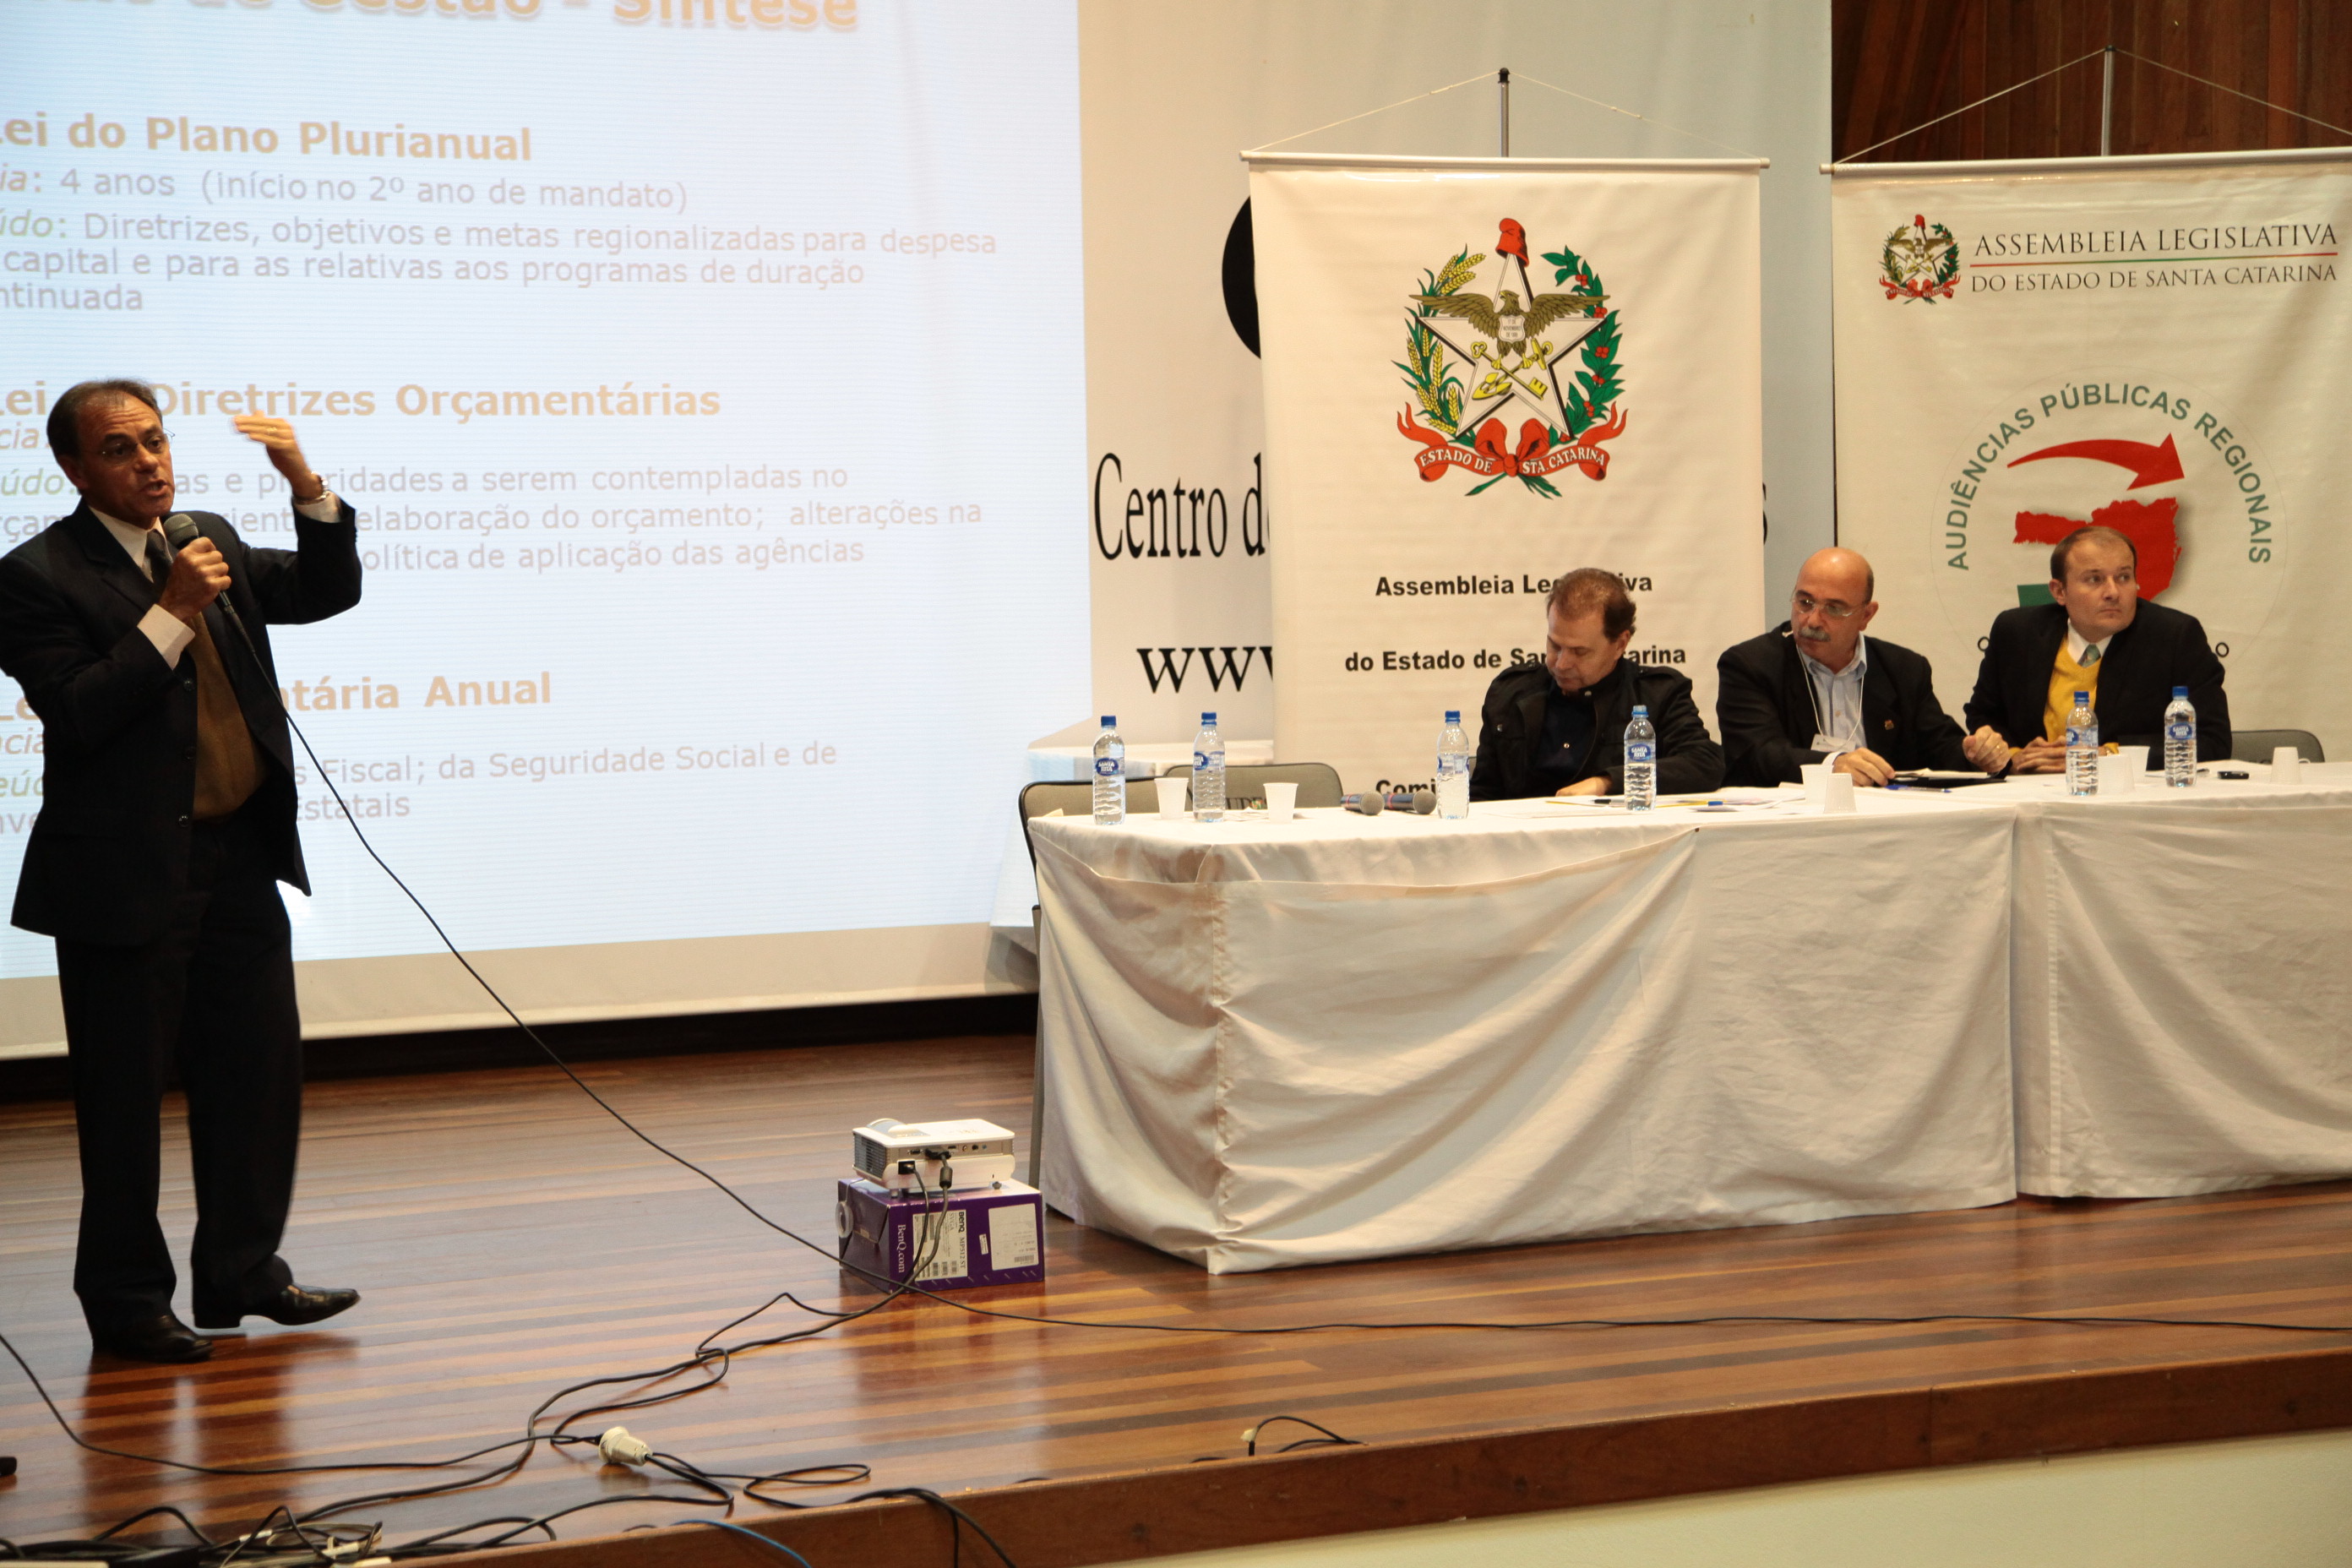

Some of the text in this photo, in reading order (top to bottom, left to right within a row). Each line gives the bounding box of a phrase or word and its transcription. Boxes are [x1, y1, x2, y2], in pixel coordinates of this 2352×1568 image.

[0, 112, 532, 161] ei do Plano Plurianual
[60, 168, 81, 194] 4
[95, 174, 175, 196] anos
[202, 169, 307, 204] (início
[317, 176, 356, 199] no
[417, 179, 474, 204] ano
[488, 178, 525, 204] de
[540, 181, 687, 215] mandato)
[84, 213, 259, 246] Diretrizes,
[272, 217, 423, 250] objetivos
[435, 225, 451, 246] e
[466, 222, 559, 248] metas
[574, 224, 794, 255] regionalizadas
[803, 230, 866, 257] para
[881, 229, 996, 259] despesa
[1974, 223, 2338, 257] ASSEMBLEIA LEGISLATIVA
[3, 248, 864, 290] capital e para as relativas aos programas de duração
[1971, 275, 2006, 293] DO
[2015, 272, 2100, 291] ESTADO
[2110, 270, 2137, 289] DE
[2145, 268, 2216, 288] SANTA
[2224, 264, 2338, 285] CATARINA
[0, 380, 721, 424] ei Diretrizes Orçamentárias
[226, 473, 242, 493] e
[454, 471, 468, 492] a
[483, 470, 576, 492] serem
[592, 464, 802, 495] contempladas
[814, 466, 847, 488] no
[1419, 447, 1606, 474] ESTADO DE STA. CATARINA
[1946, 407, 2035, 571] AUDIÊNCIAS
[2039, 383, 2191, 421] PÚBLICAS
[2194, 411, 2273, 564] REGIONAIS
[357, 501, 530, 536] elaboração
[542, 504, 579, 529] do
[592, 500, 763, 534] orçamento;
[790, 498, 938, 529] alterações
[949, 501, 982, 523] na
[1094, 452, 1271, 560] Centro d
[362, 537, 863, 574] olítica de aplicação das agências
[1375, 574, 1515, 596] Assembleia
[1345, 651, 1374, 672] do
[1383, 650, 1466, 671] Estado
[1473, 648, 1502, 668] de
[1623, 645, 1686, 665] arina
[424, 672, 550, 706] Anual
[322, 754, 424, 785] Fiscal;
[438, 754, 475, 778] da
[489, 748, 665, 781] Seguridade
[676, 743, 764, 770] Social
[775, 747, 789, 765] e
[803, 741, 836, 765] de
[896, 1224, 907, 1274] BenQ.com
